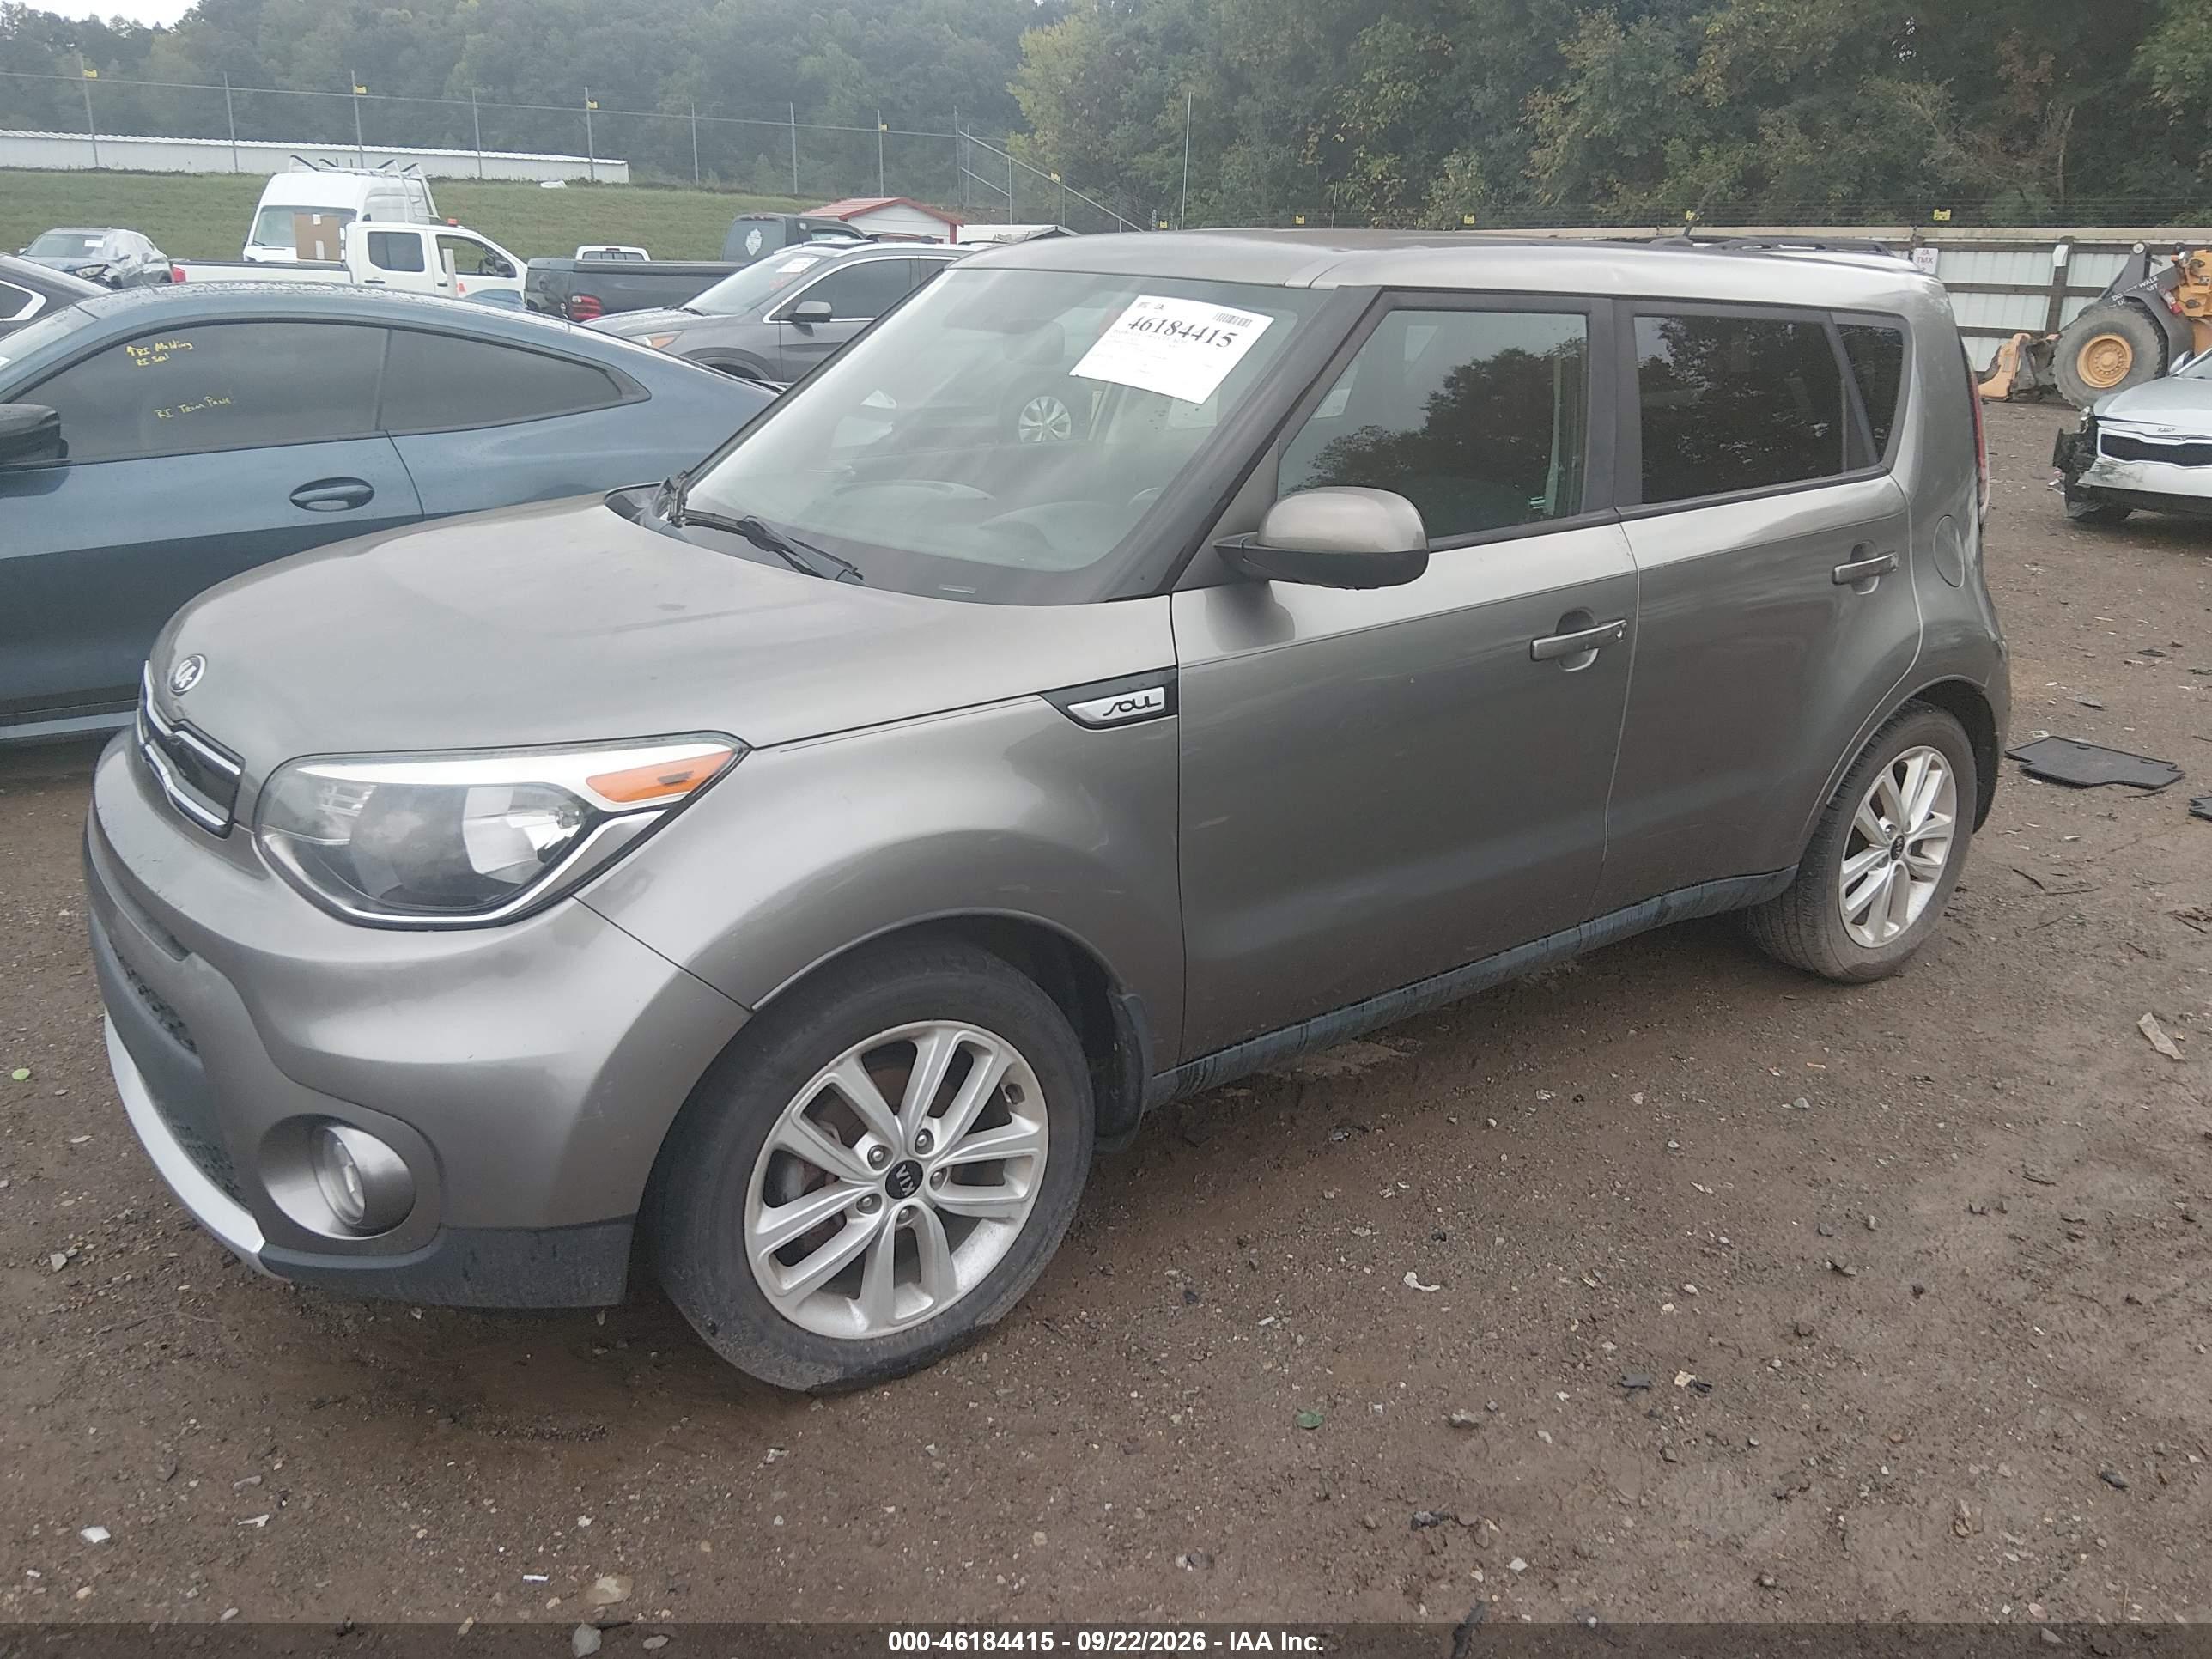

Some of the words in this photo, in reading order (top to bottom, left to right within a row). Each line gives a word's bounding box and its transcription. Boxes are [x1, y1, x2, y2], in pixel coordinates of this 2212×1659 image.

[2138, 275, 2159, 288] WALK
[1127, 315, 1239, 348] 46184415
[1103, 696, 1161, 716] SOUL
[896, 1164, 915, 1196] KIA
